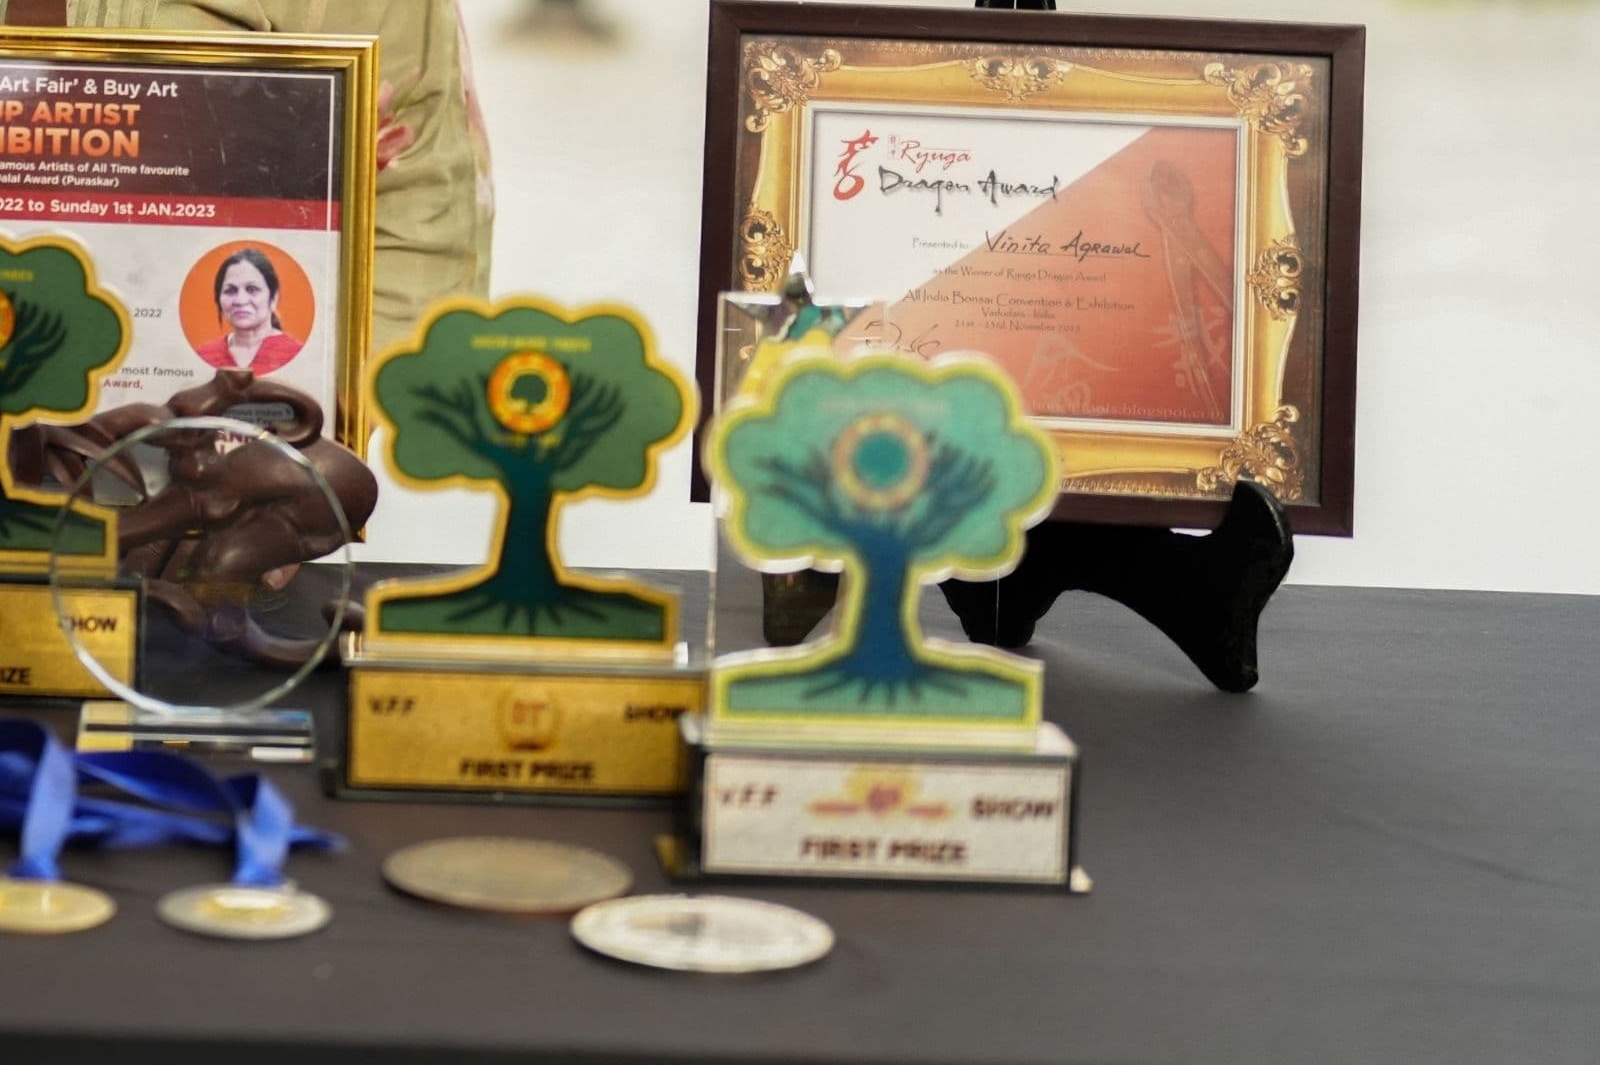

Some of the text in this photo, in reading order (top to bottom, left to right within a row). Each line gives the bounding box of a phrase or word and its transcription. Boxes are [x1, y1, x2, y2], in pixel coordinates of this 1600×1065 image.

[83, 81, 98, 94] &
[103, 81, 141, 98] Buy
[147, 81, 178, 98] Art
[31, 101, 141, 126] ARTIST
[900, 140, 973, 173] Ryuga
[38, 161, 75, 173] Artists
[77, 162, 90, 173] of
[92, 163, 107, 174] All
[111, 164, 137, 175] Time
[140, 165, 189, 176] favourite
[24, 174, 59, 184] Award
[62, 174, 120, 188] (Puraskar)
[878, 165, 1059, 215] Dragon Award
[28, 200, 45, 212] to
[50, 199, 108, 216] Sunday
[113, 201, 134, 215] 1st
[137, 202, 216, 218] JAN.2023
[912, 237, 958, 250] Presented
[985, 230, 1050, 255] Vinita
[961, 266, 992, 277] Winner
[902, 289, 921, 302] All
[923, 289, 949, 303] India
[952, 290, 993, 305] Bonsai
[996, 292, 1062, 307] Convention
[1076, 297, 1135, 311] Exhibition
[133, 308, 162, 319] 2022
[121, 366, 194, 377] most famous
[103, 379, 144, 390] Award,
[459, 758, 595, 781] FIRST PRIZE
[969, 794, 1057, 820] SHOW
[801, 837, 968, 864] FIRST PRIZE
